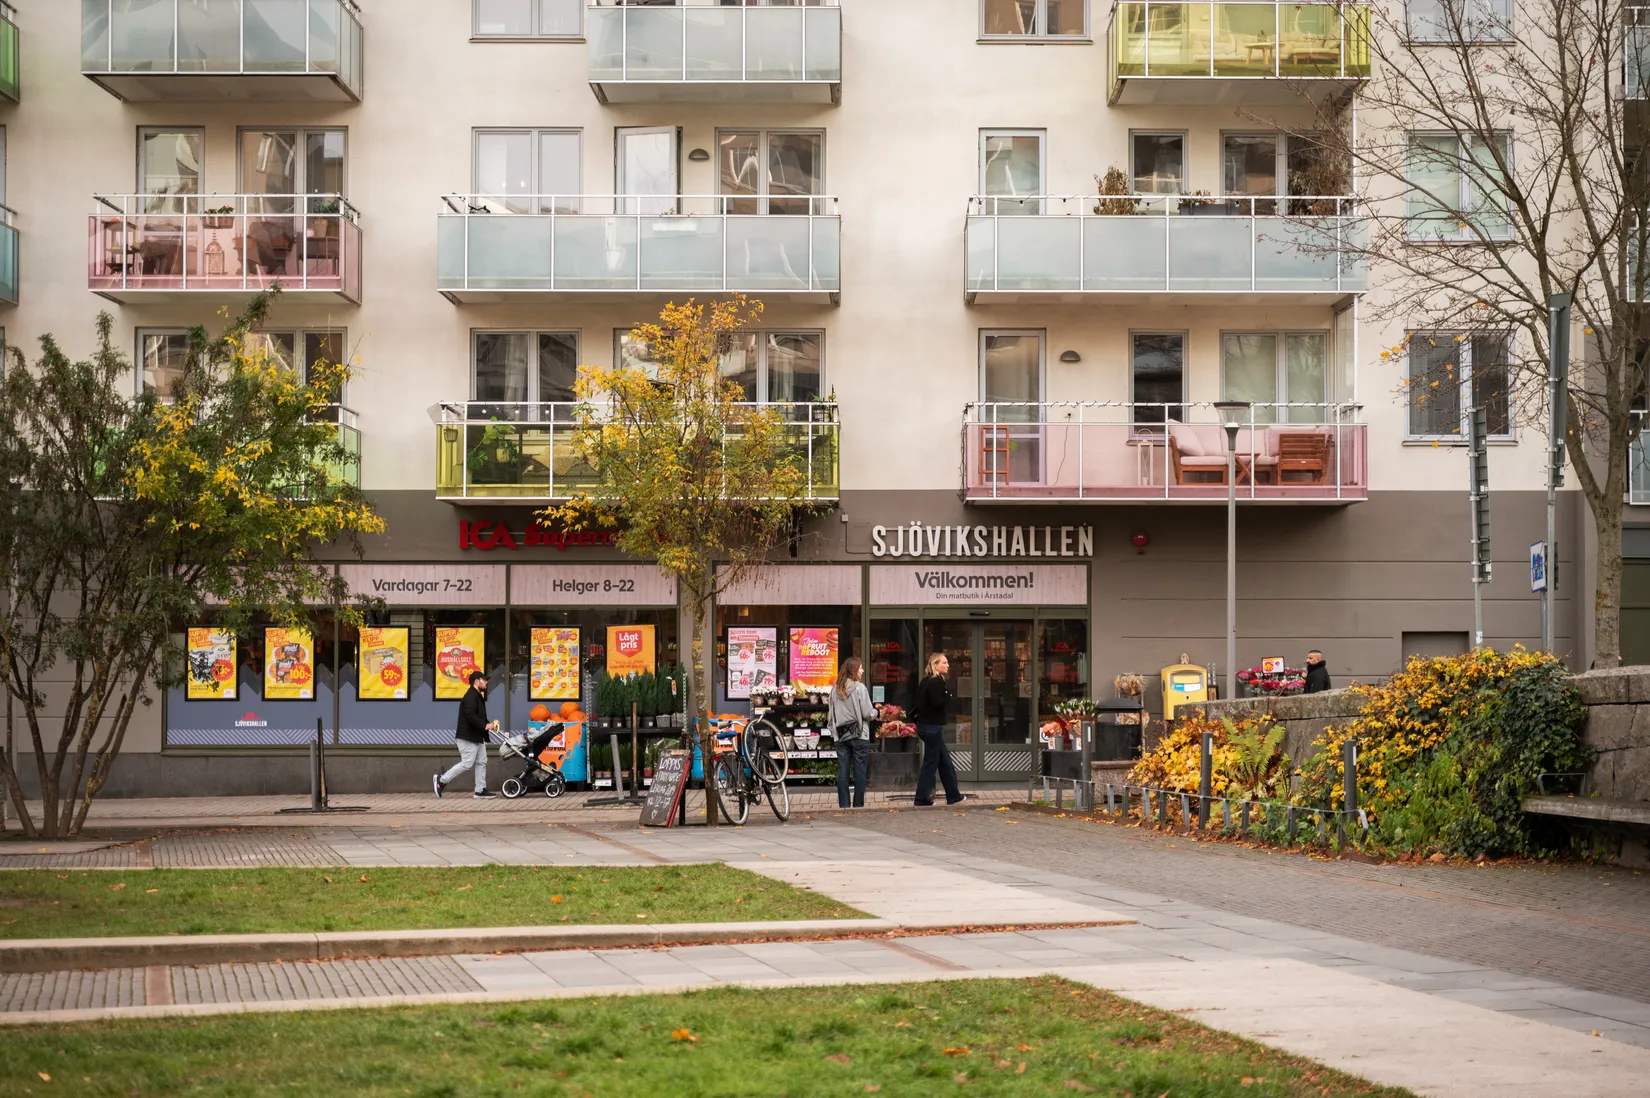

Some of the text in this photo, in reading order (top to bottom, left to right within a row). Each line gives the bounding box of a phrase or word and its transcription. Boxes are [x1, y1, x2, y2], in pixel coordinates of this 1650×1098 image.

[460, 520, 517, 549] ICA
[872, 520, 1093, 557] SJÖVIKSHALLEN
[915, 571, 1034, 589] Välkommen!
[372, 579, 439, 594] Vardagar
[552, 579, 599, 595] Helger
[984, 590, 1014, 599] Årstadal
[436, 629, 457, 638] SUPER
[619, 632, 638, 642] Lågt
[620, 640, 638, 651] pris
[290, 669, 311, 679] 100:-
[383, 669, 400, 680] 59:-
[659, 757, 682, 771] LOPPIS
